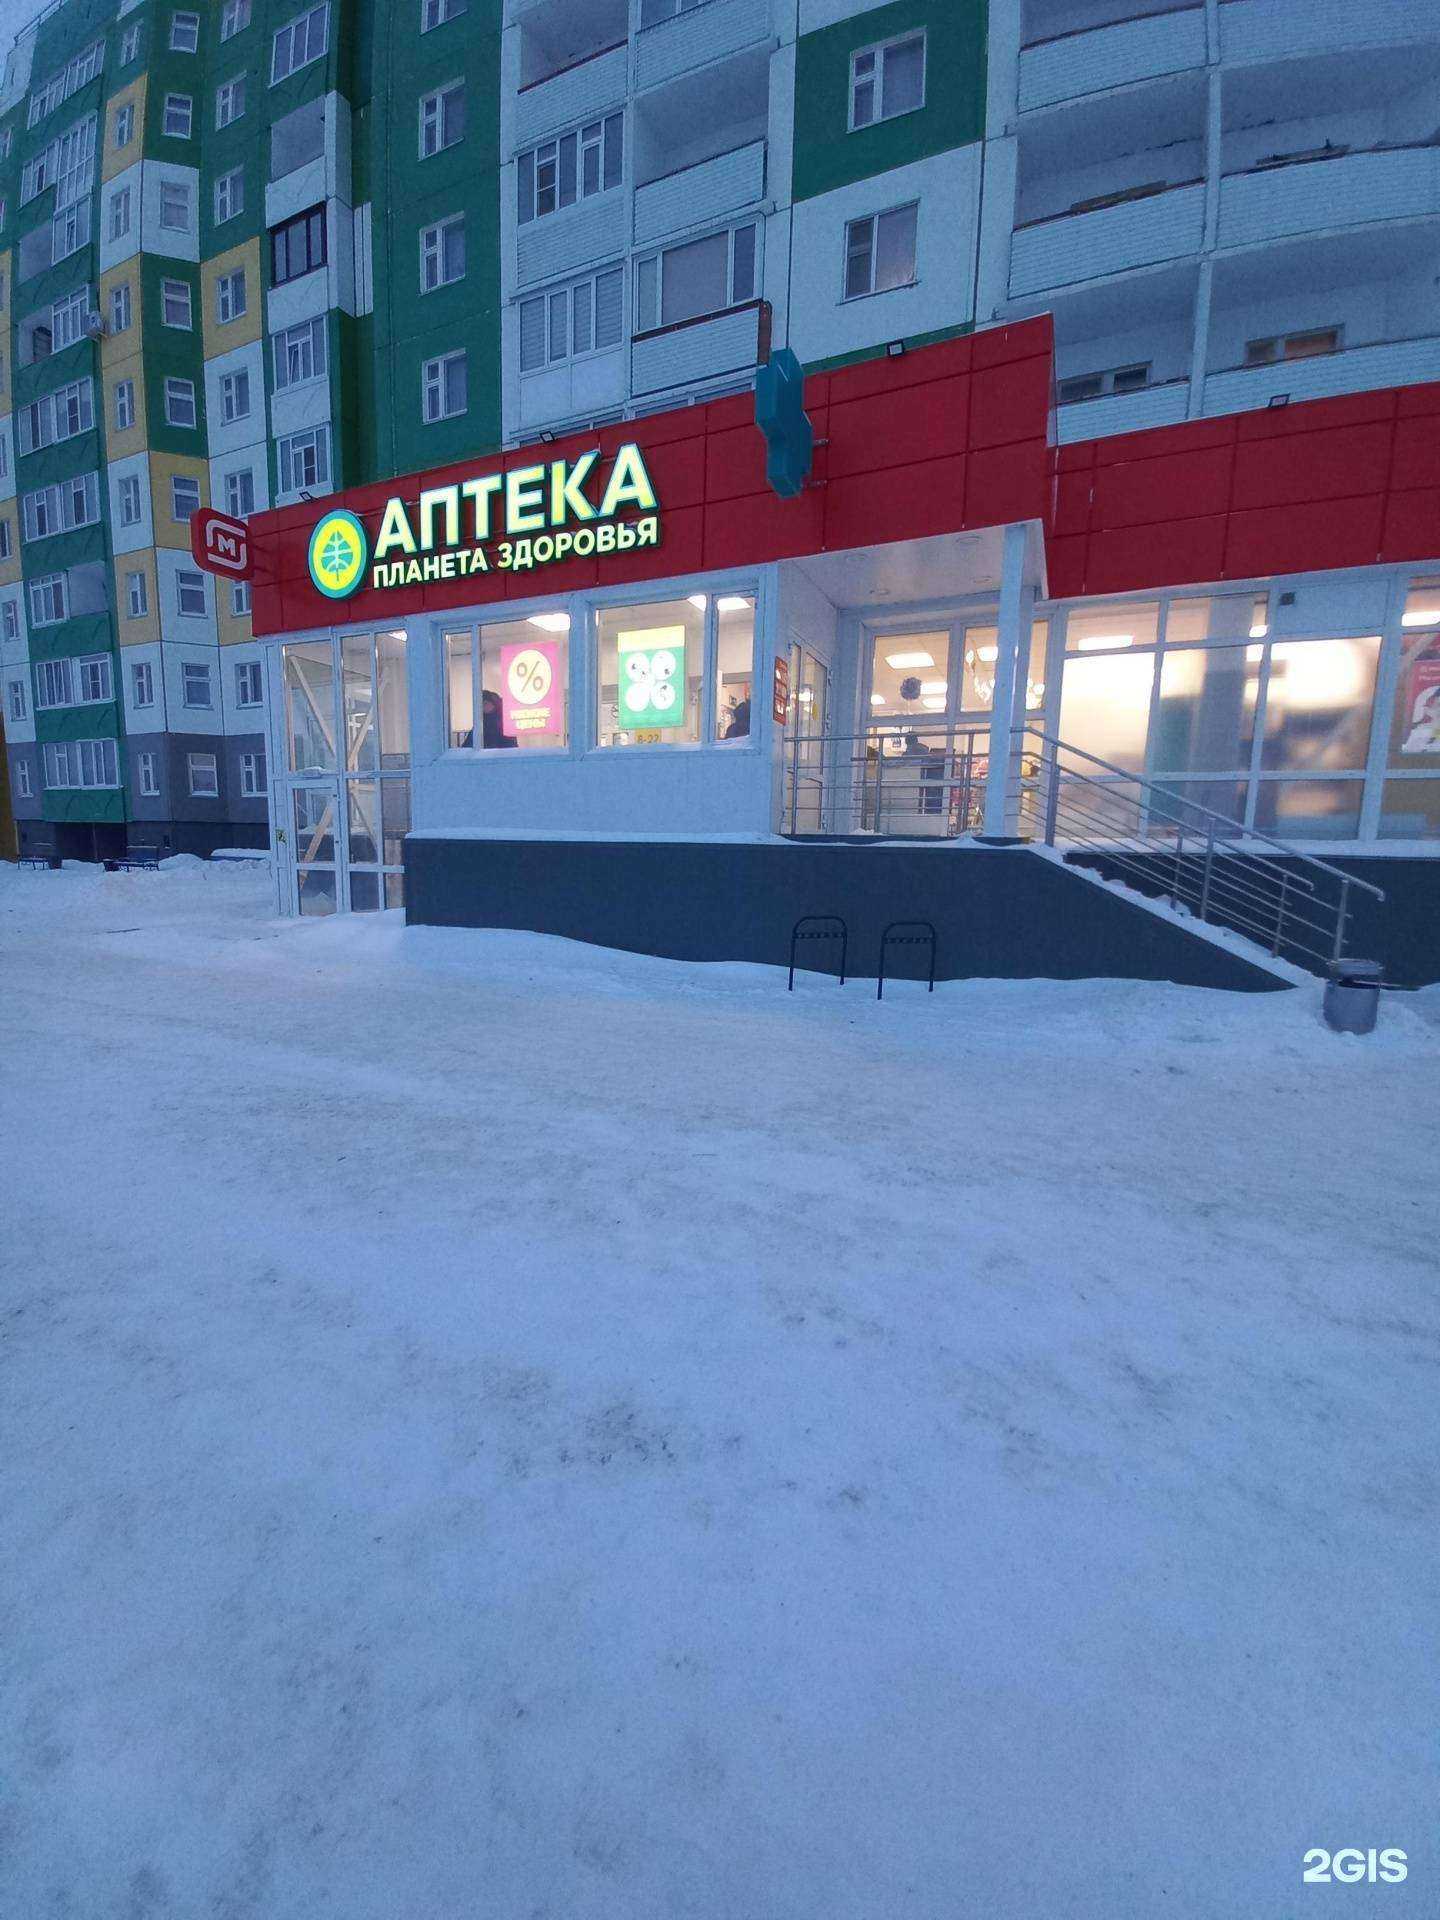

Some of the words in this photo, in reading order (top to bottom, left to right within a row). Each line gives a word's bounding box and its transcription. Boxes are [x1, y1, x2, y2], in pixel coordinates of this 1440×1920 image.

[373, 443, 658, 560] АПТЕКА
[373, 548, 488, 588] ПЛАНЕТА
[497, 517, 658, 571] ЗДОРОВЬЯ
